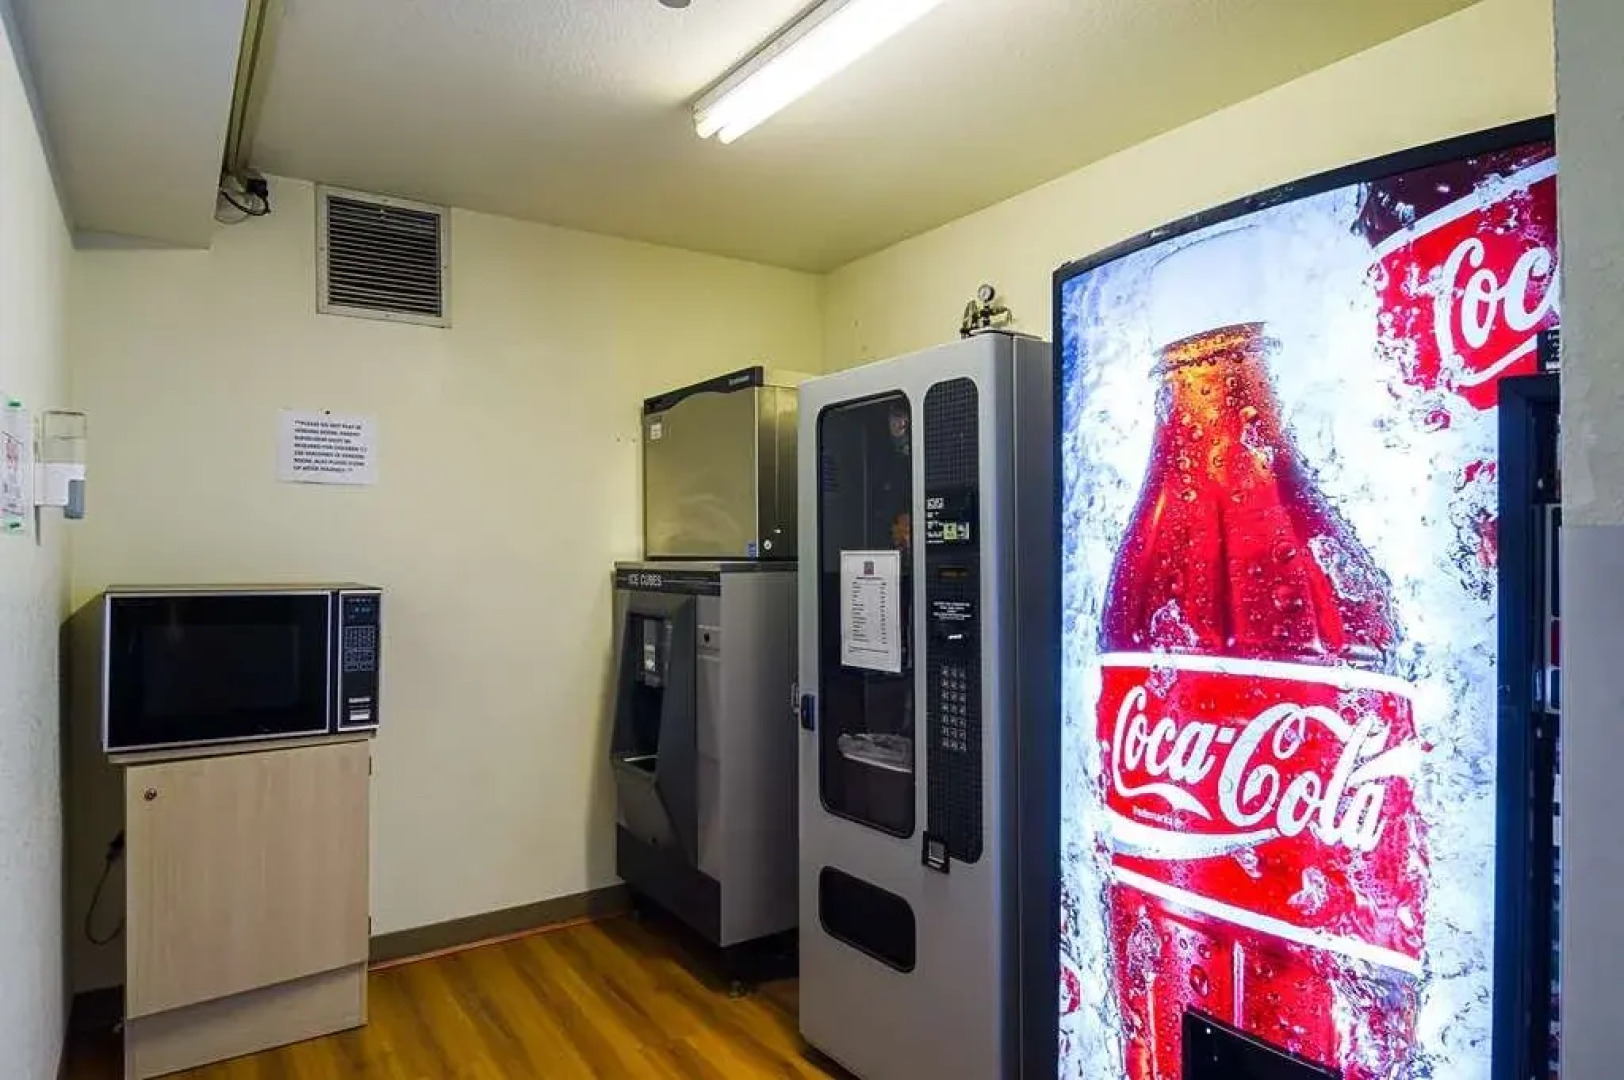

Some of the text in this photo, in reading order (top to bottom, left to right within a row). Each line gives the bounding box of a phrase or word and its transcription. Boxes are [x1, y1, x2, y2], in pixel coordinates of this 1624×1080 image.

[1432, 237, 1558, 388] Coc
[627, 573, 662, 587] ICE CUBES
[1112, 685, 1424, 853] Coca-Cola
